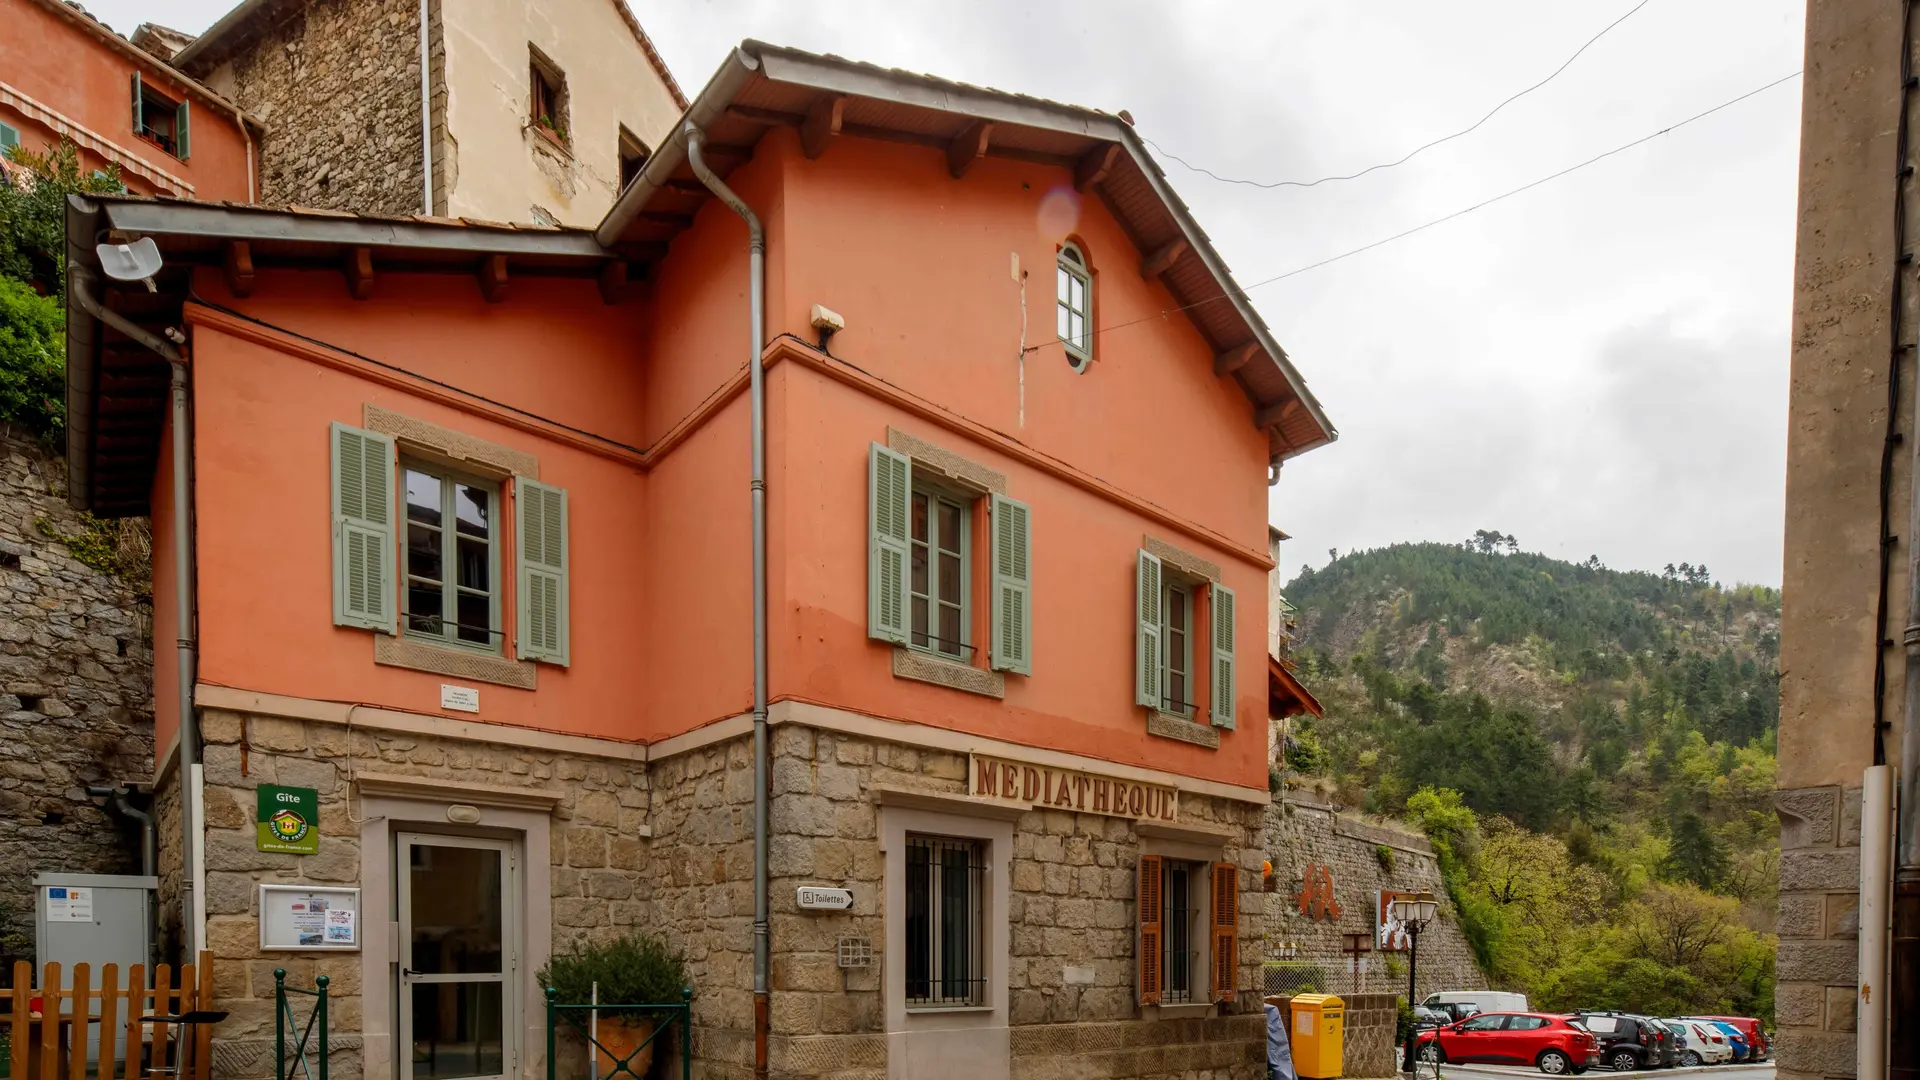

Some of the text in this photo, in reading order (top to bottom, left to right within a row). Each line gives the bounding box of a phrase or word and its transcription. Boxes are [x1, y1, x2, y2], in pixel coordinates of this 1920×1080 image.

[976, 758, 1176, 821] MEDIATHEQUE
[276, 792, 301, 803] Gîte
[815, 893, 844, 904] Toilettes
